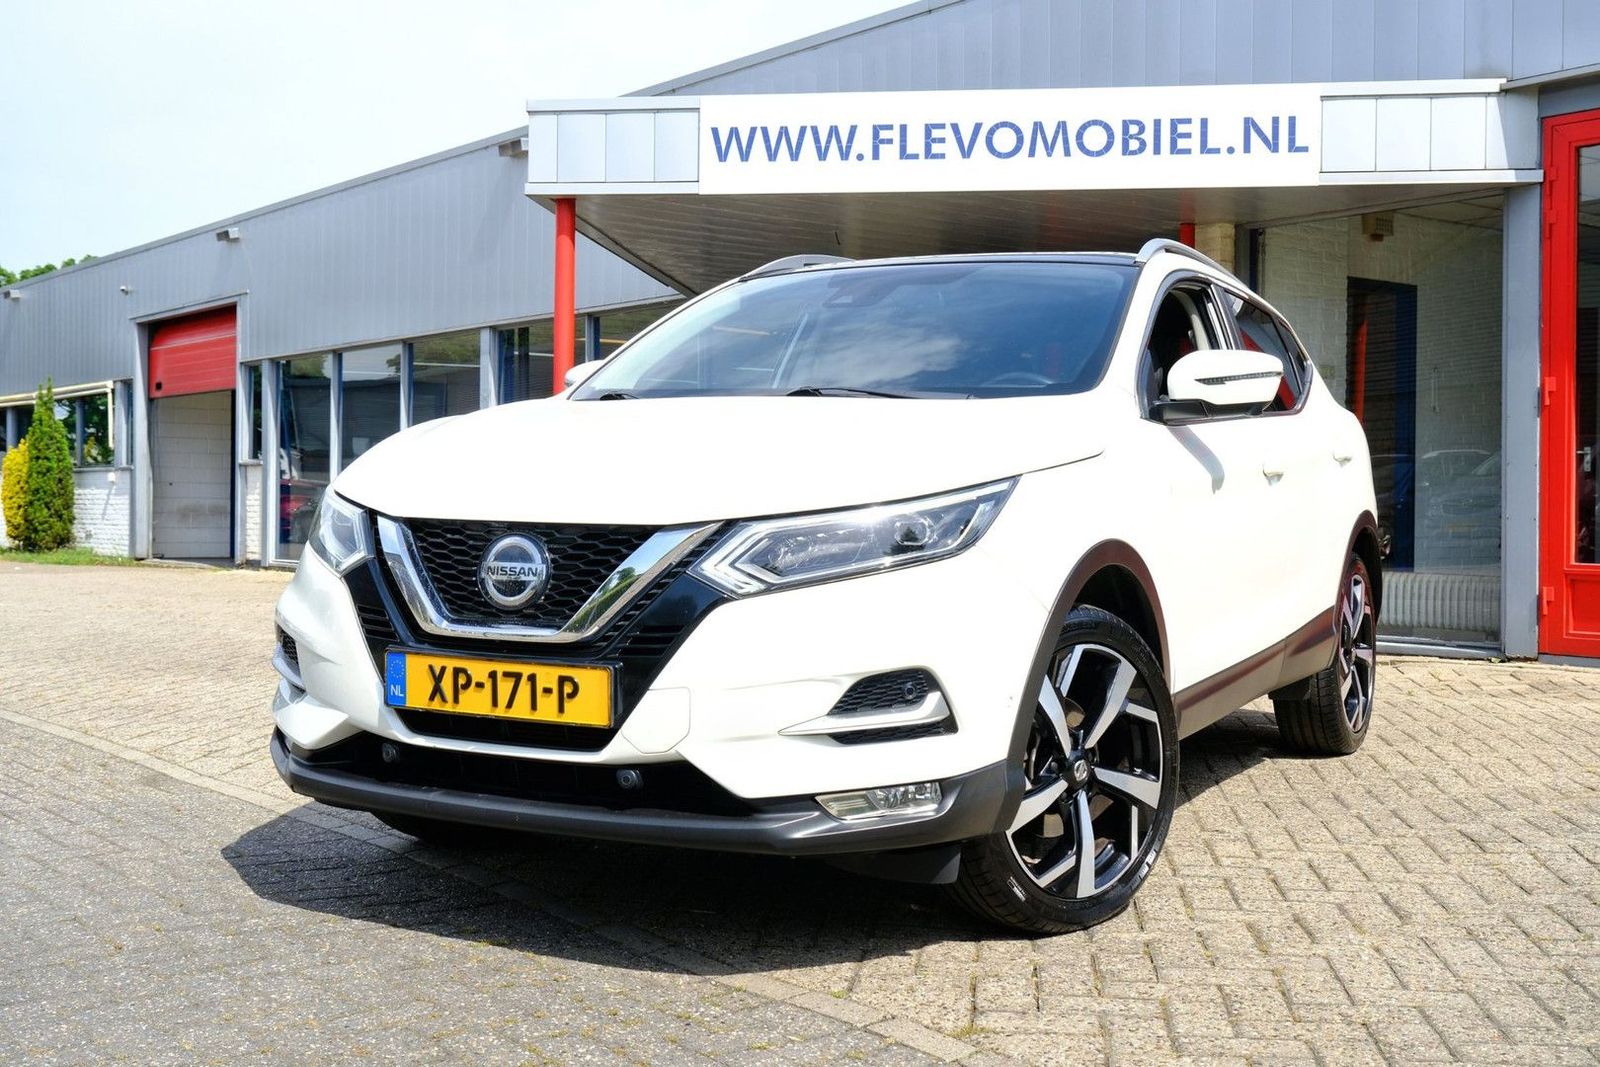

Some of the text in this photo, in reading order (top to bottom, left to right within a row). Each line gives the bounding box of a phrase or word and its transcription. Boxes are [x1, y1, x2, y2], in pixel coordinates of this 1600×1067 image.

[711, 116, 1309, 162] WWW.FLEVOMOBIEL.NL
[486, 565, 538, 578] NISSAN
[390, 684, 404, 697] NL
[428, 664, 580, 714] XP-171-P
